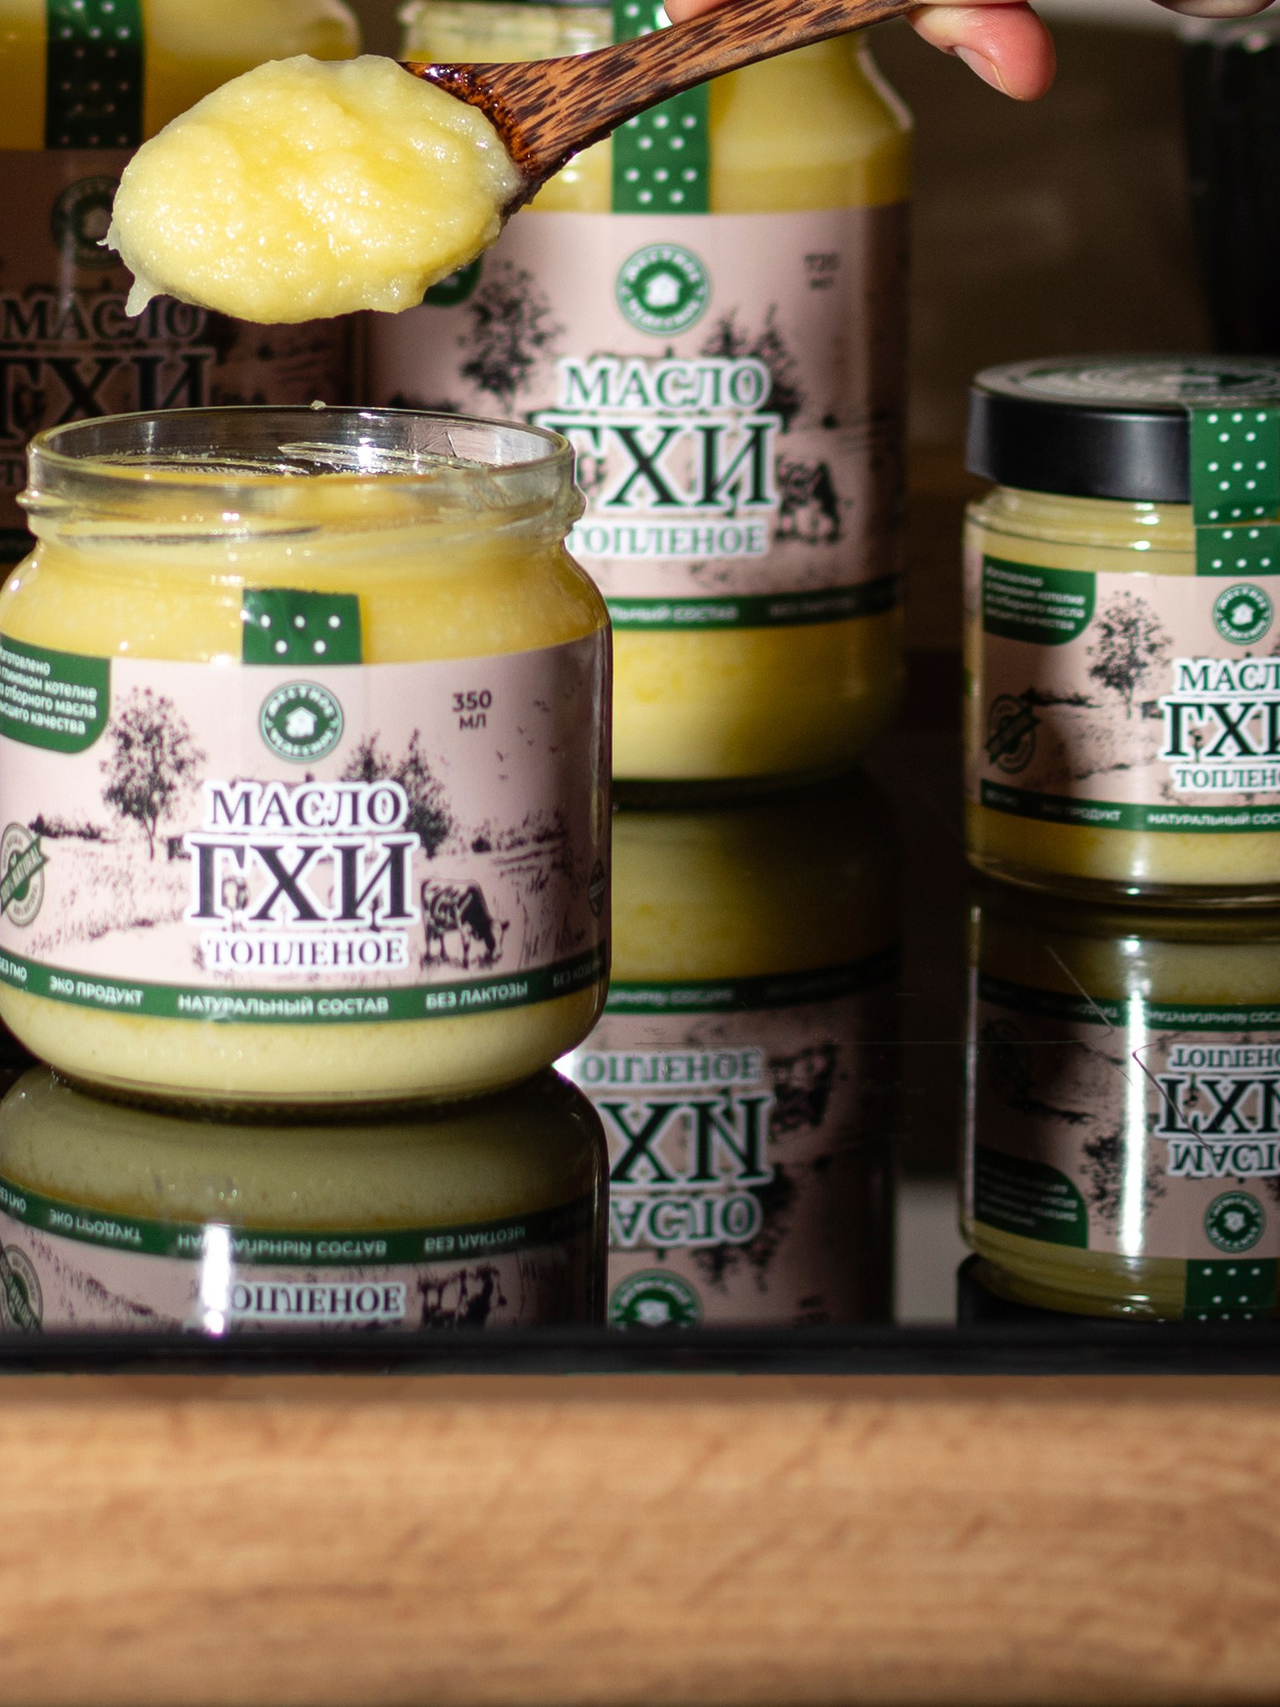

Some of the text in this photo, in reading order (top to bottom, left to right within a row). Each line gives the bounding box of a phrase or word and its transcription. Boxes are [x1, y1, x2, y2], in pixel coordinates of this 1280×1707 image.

[565, 367, 764, 407] МАСЛО
[44, 680, 98, 702] котелке
[453, 690, 492, 712] 350
[54, 698, 98, 720] масла
[30, 711, 86, 735] качества
[459, 713, 487, 730] МЛ
[1175, 768, 1280, 789] ТОПЛЕН
[211, 789, 402, 828] МАСЛО
[190, 841, 416, 921] ГХИ
[208, 937, 404, 966] ТОПЛЕНОЕ
[9, 961, 28, 982] ГМО
[49, 975, 75, 994] ЭКО
[76, 981, 144, 1006] ПРОДУКТ
[178, 994, 313, 1015] НАТУРАЛЬНЫЙ
[317, 997, 389, 1016] СОСТАВ
[426, 992, 456, 1010] БЕЗ
[460, 981, 528, 1007] ЛАКТОЗЫ
